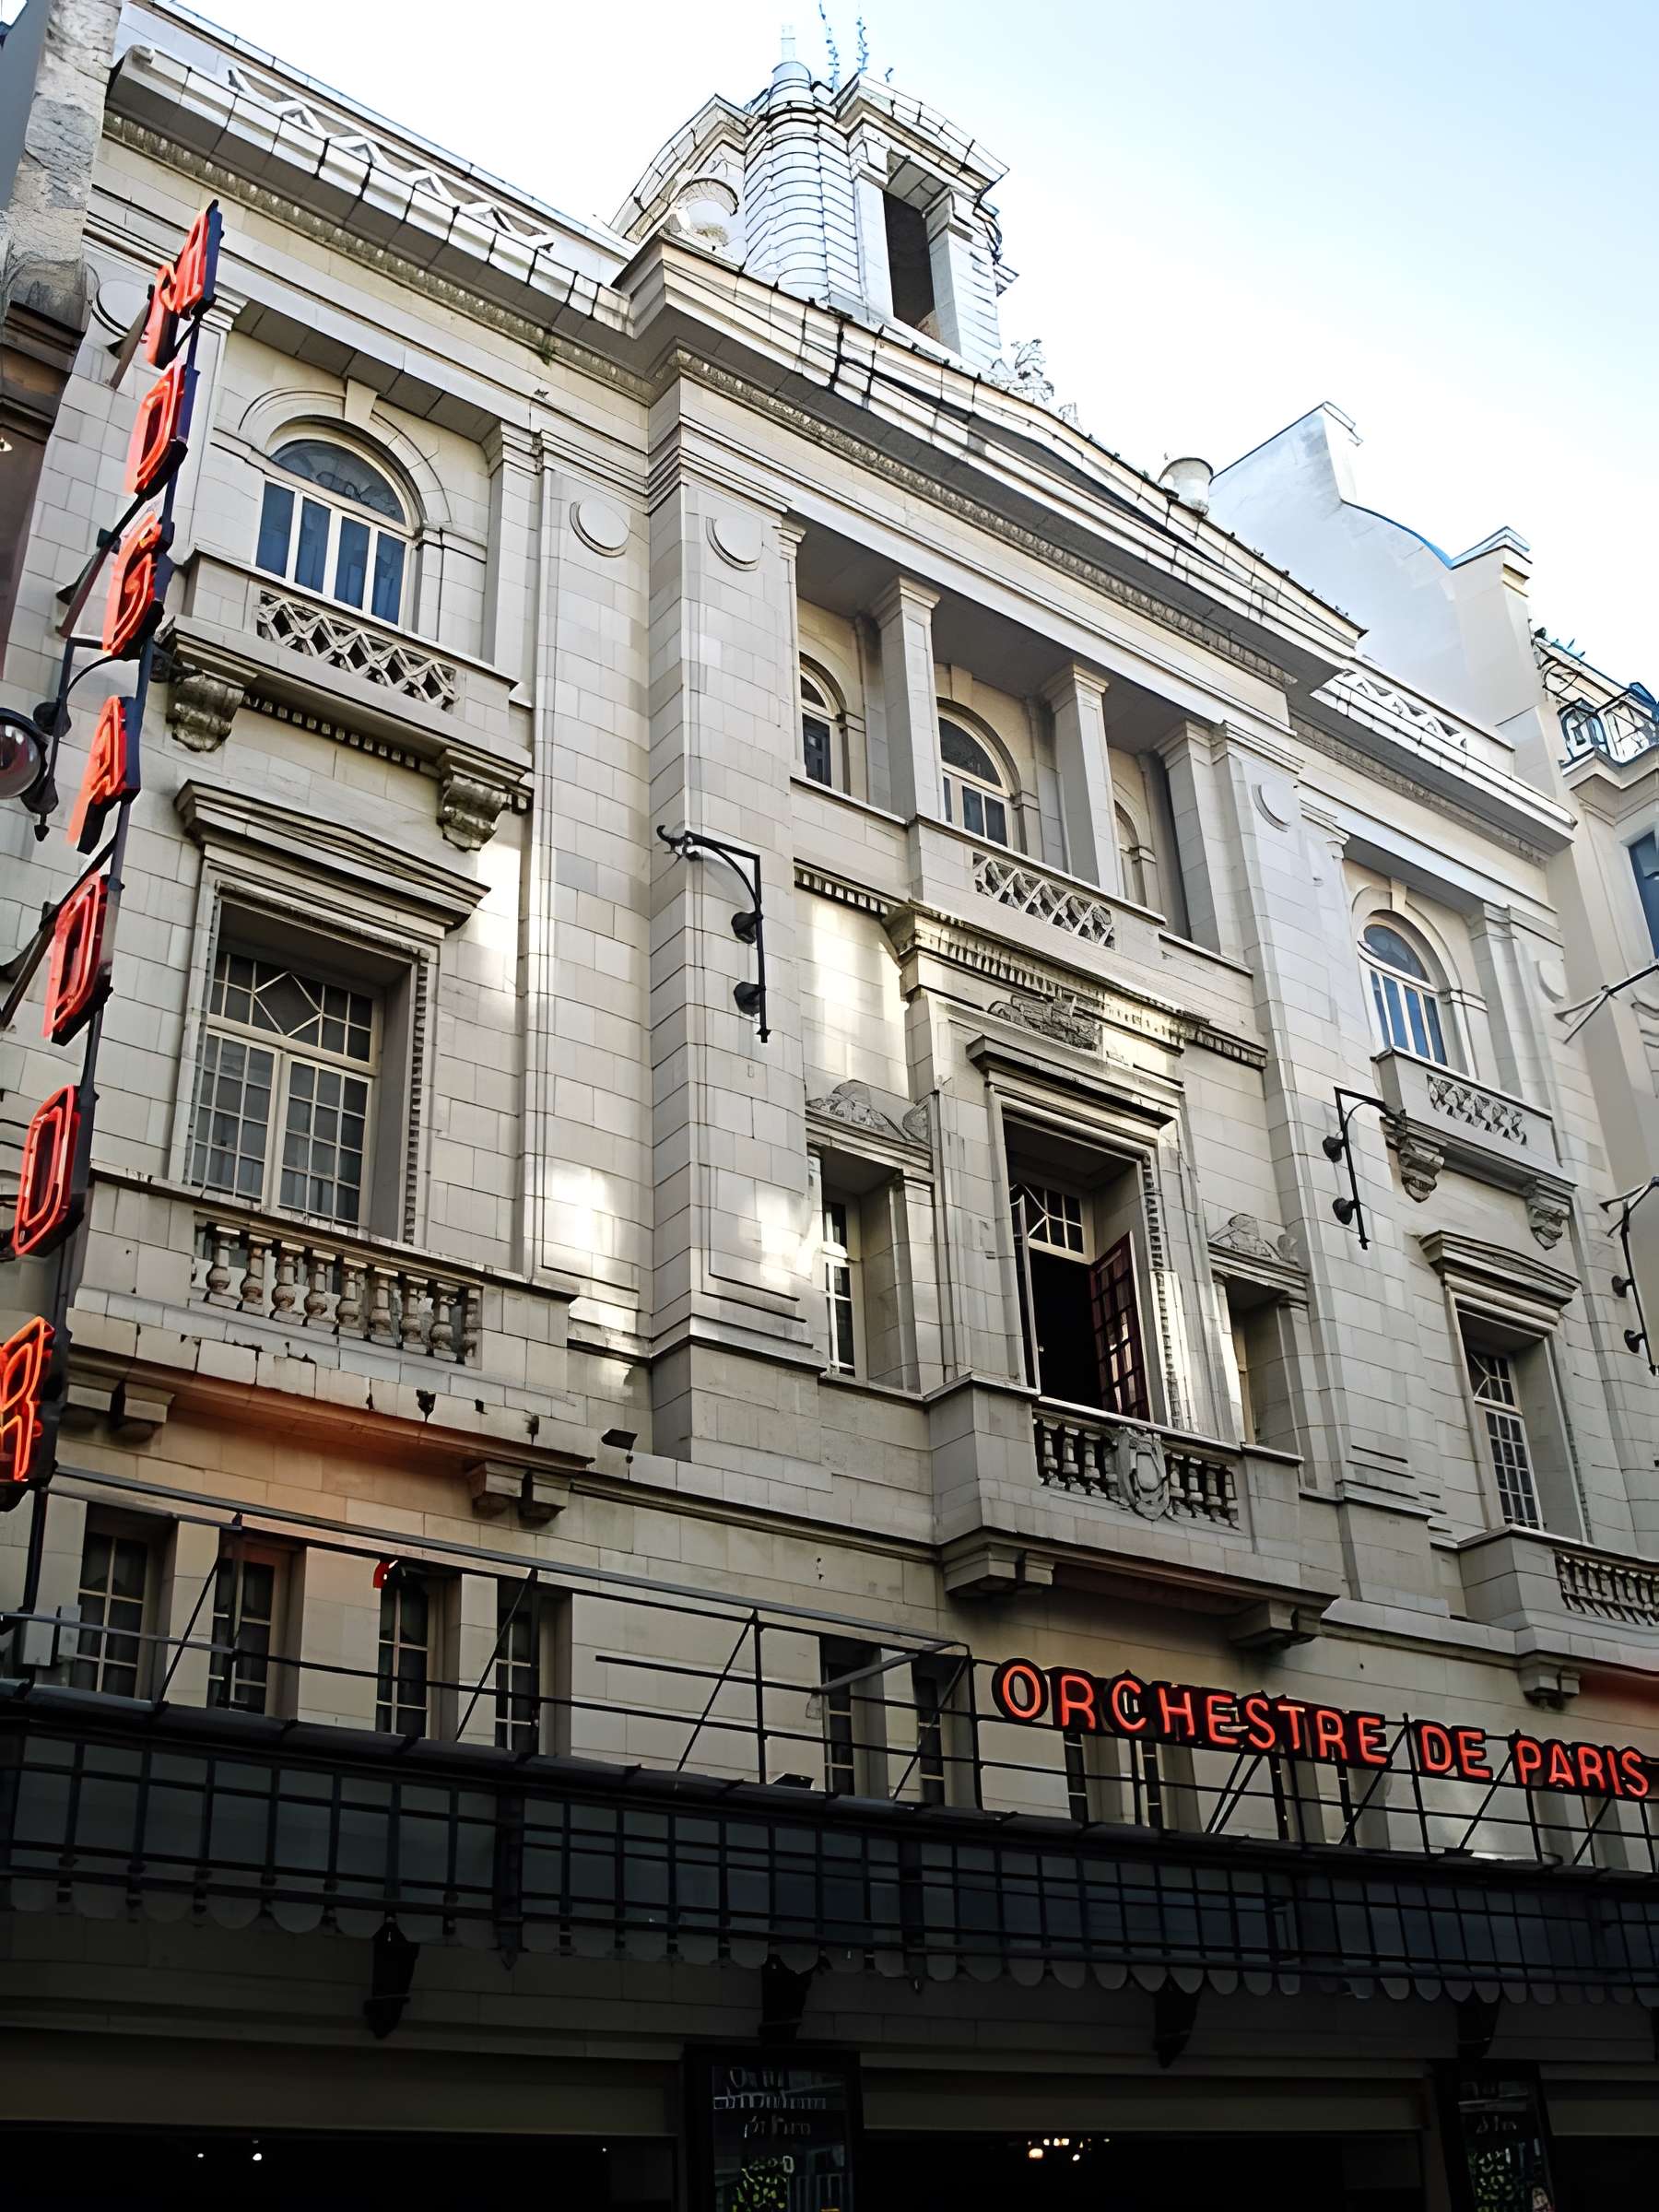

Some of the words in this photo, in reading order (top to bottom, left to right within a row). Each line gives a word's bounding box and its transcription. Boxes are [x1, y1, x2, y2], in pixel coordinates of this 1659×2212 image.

[999, 1663, 1390, 1765] ORCHESTRE
[1420, 1724, 1494, 1779] DE
[1515, 1739, 1650, 1798] PARIS
